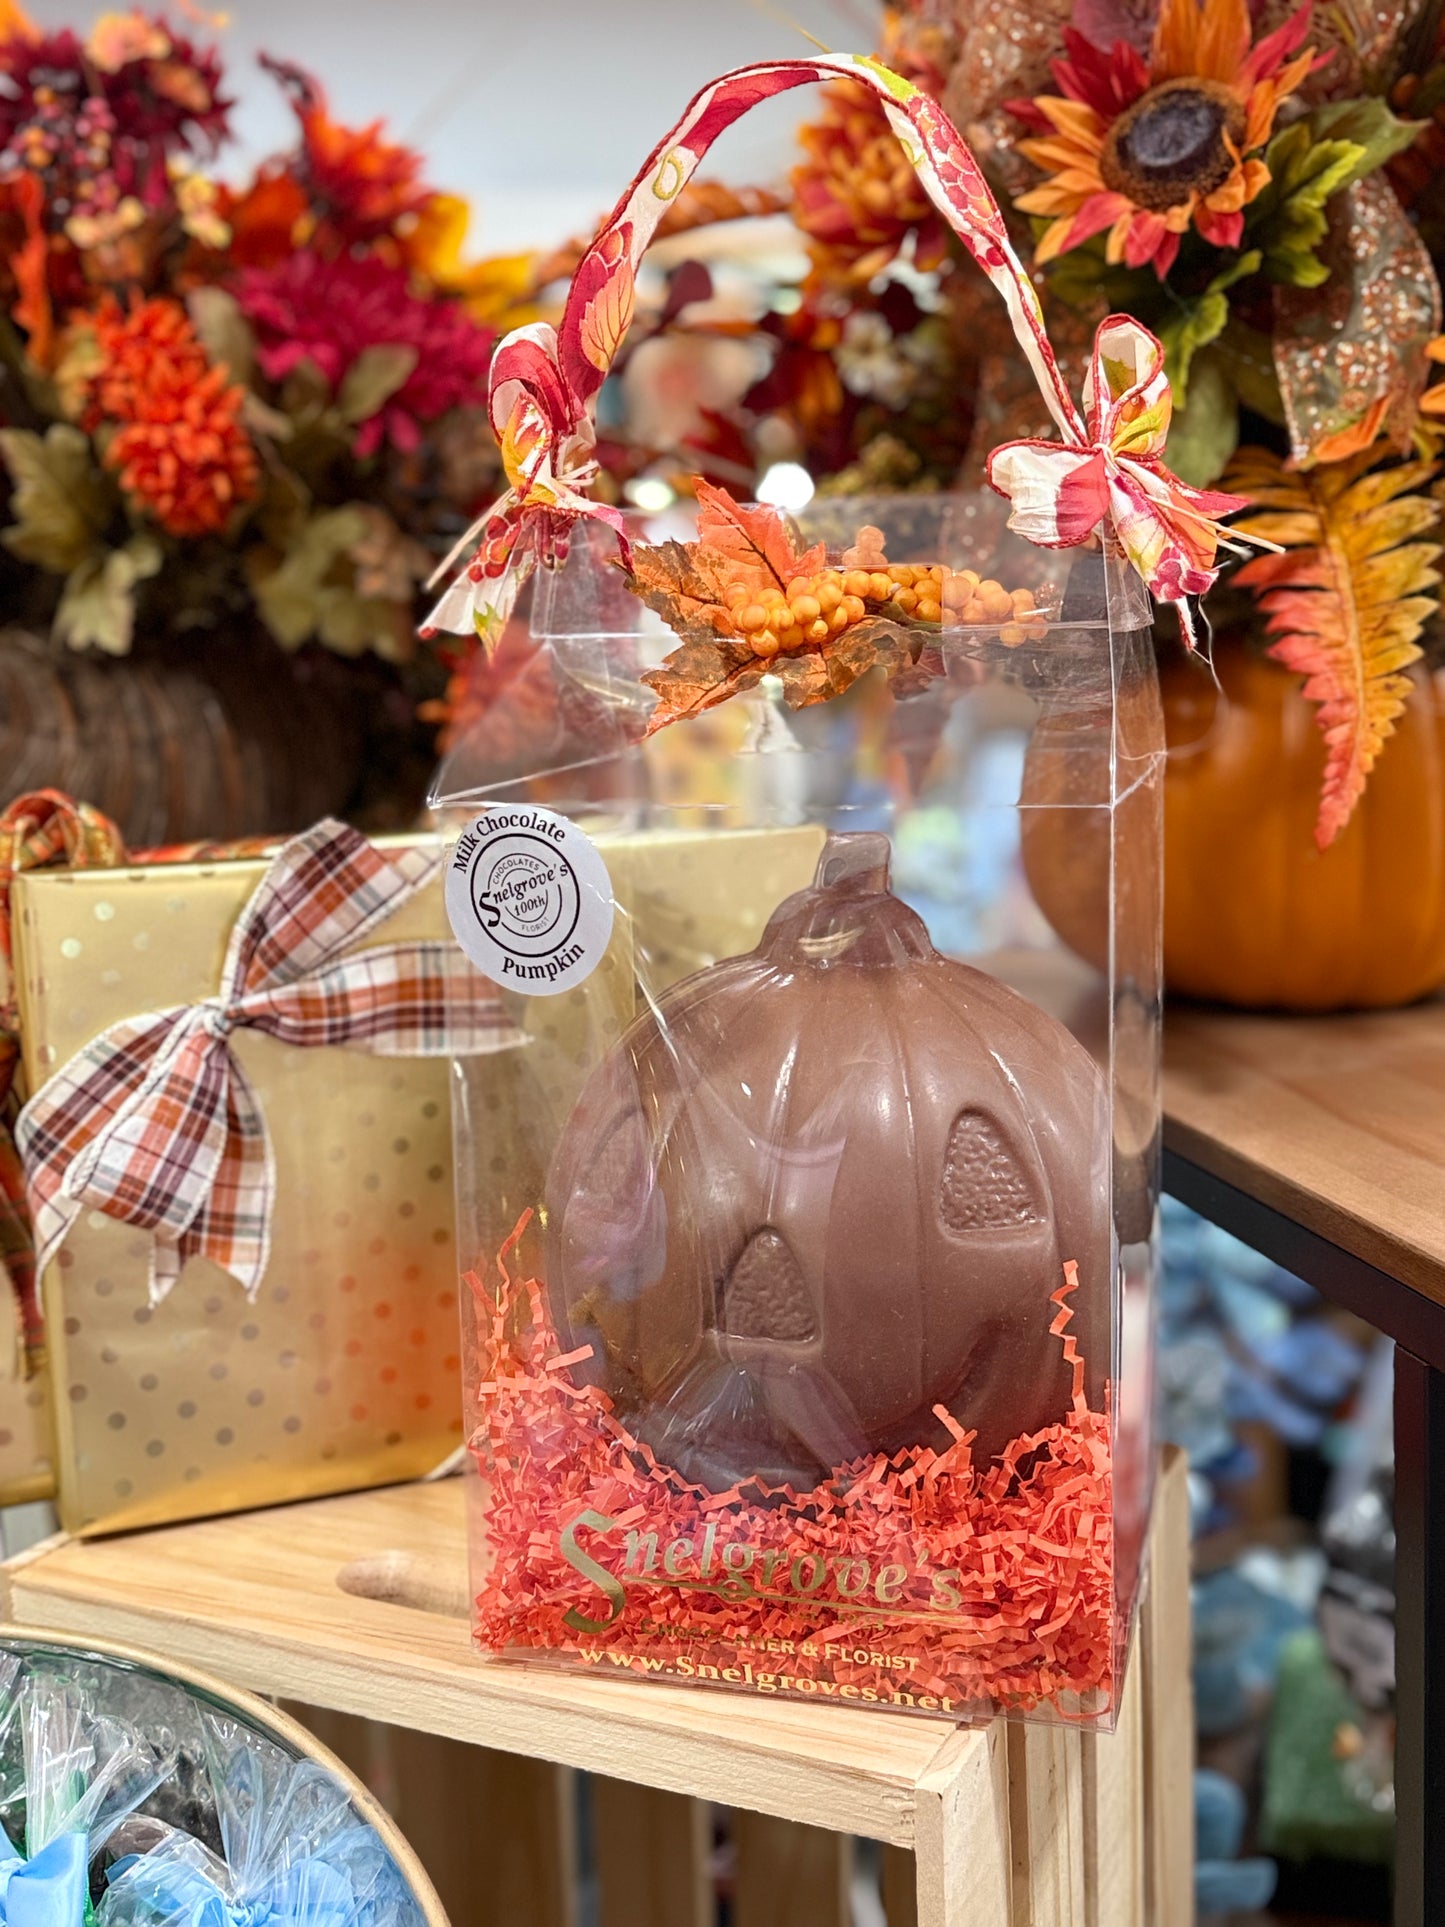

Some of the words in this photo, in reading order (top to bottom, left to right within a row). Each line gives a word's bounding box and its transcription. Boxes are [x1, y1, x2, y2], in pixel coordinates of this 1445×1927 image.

[453, 833, 480, 874] Milk
[476, 812, 566, 843] Chocolate
[492, 857, 540, 885] CHOCOLATES
[479, 864, 569, 928] Snelgrove's
[513, 895, 546, 917] 100th
[521, 916, 550, 932] FLORIST
[501, 943, 586, 982] Pumpkin
[559, 1508, 963, 1634] Snelgrove's
[801, 1641, 818, 1657] &
[825, 1643, 919, 1672] FLORIST
[578, 1647, 956, 1714] www.Snelgroves.net
